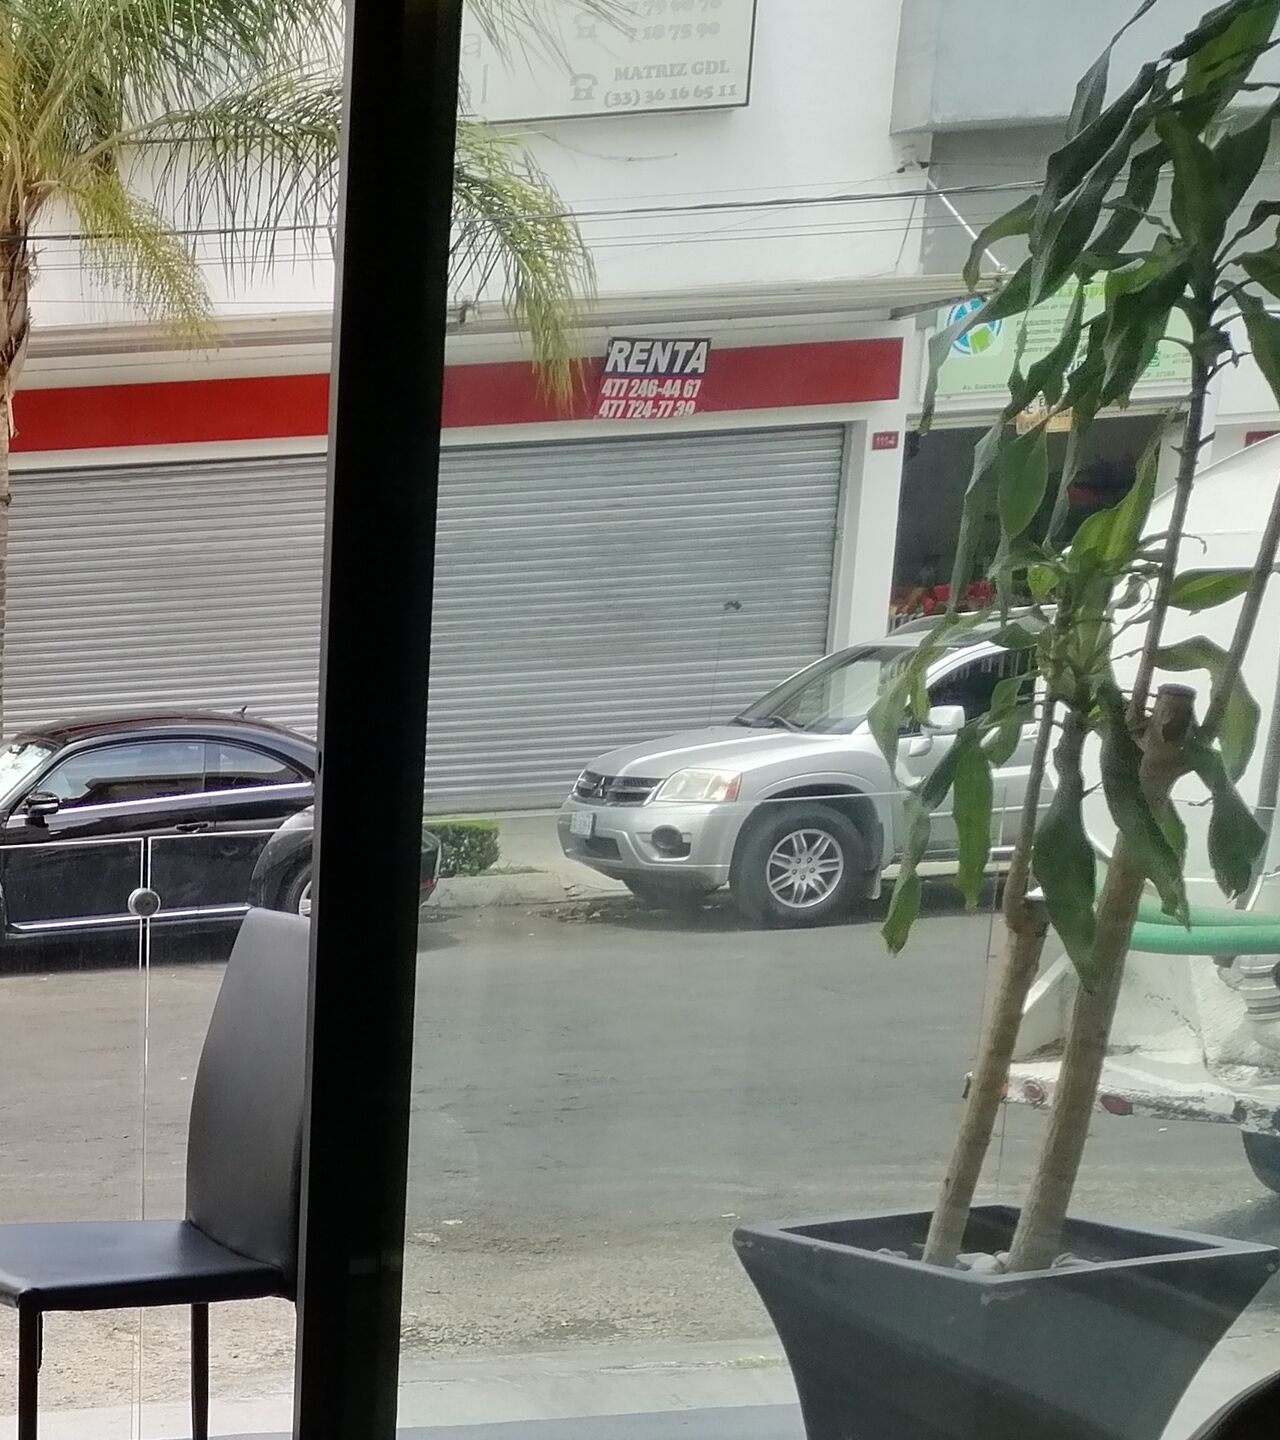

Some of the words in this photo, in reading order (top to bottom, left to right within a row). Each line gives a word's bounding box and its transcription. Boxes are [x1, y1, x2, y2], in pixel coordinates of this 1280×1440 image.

[614, 62, 688, 81] MATRIZ
[691, 59, 730, 76] GDL
[604, 89, 641, 108] (33)
[644, 87, 666, 104] 36
[668, 86, 690, 101] 16
[693, 83, 715, 99] 65
[718, 83, 738, 97] 11
[604, 341, 708, 373] RENTA
[601, 378, 629, 398] 477
[629, 378, 682, 398] 246-44
[682, 378, 702, 398] 67
[598, 400, 627, 418] 477
[626, 400, 674, 418] 724-77
